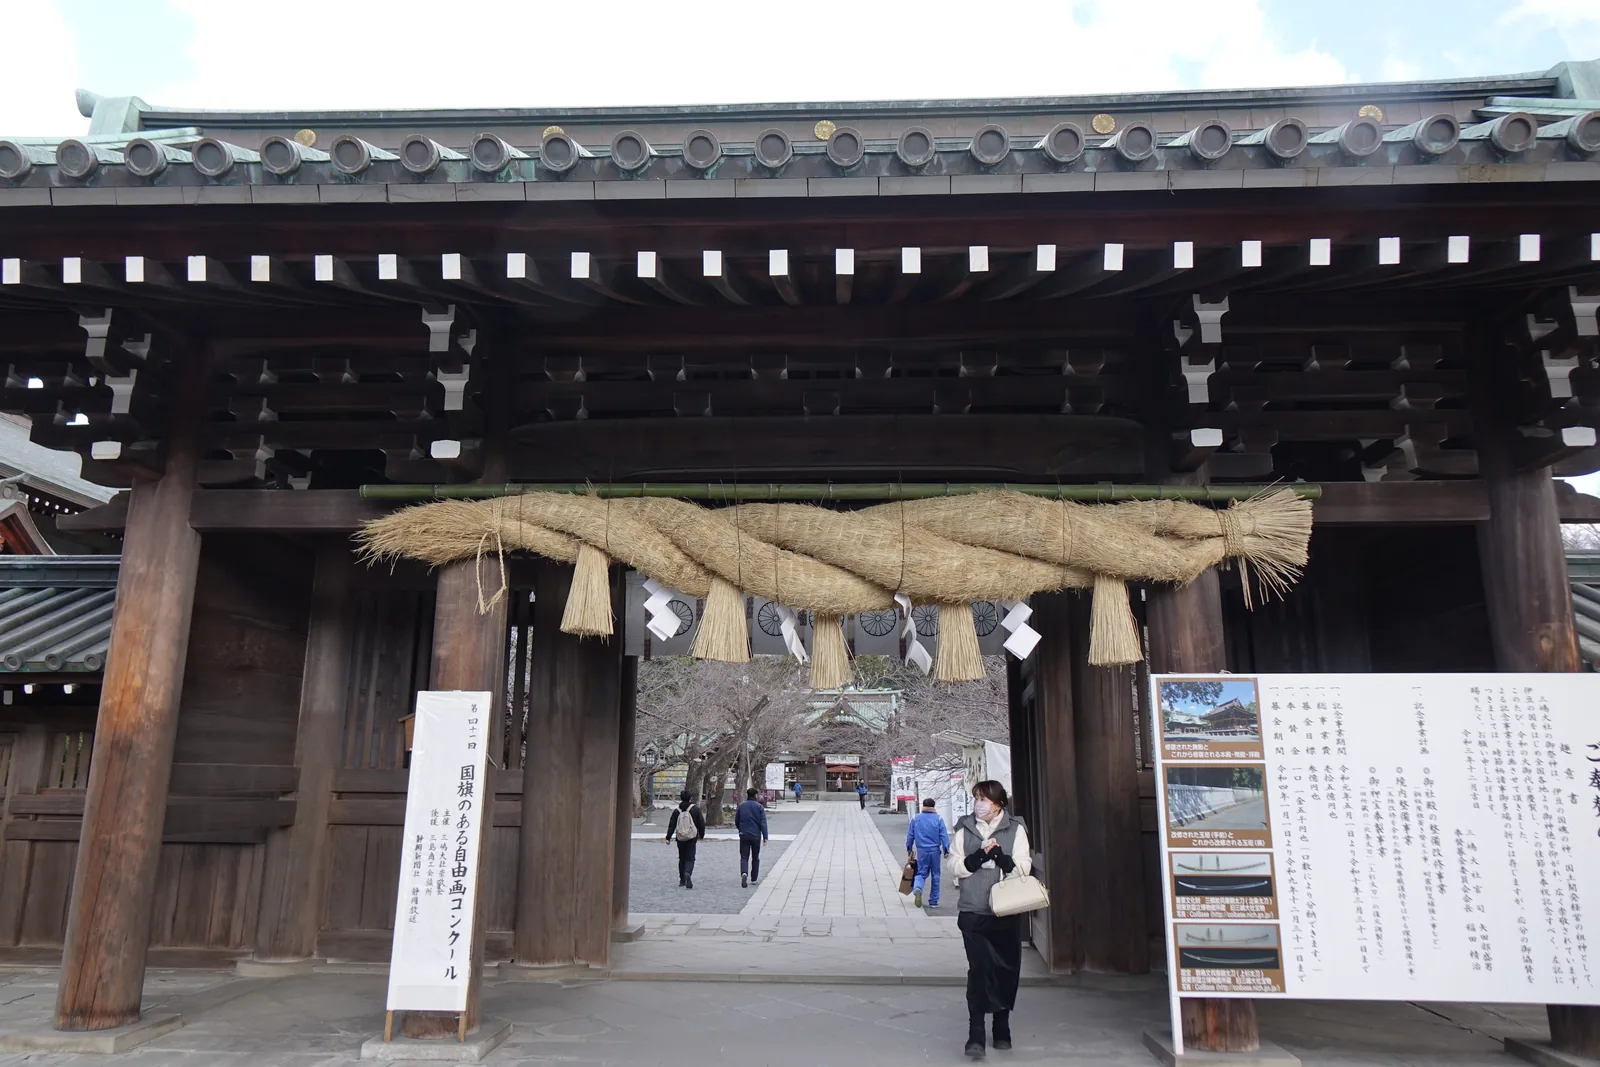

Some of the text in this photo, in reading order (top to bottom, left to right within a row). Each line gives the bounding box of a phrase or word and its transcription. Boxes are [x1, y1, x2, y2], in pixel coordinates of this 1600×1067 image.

[444, 764, 475, 980] 国旗のある自由画コンクール
